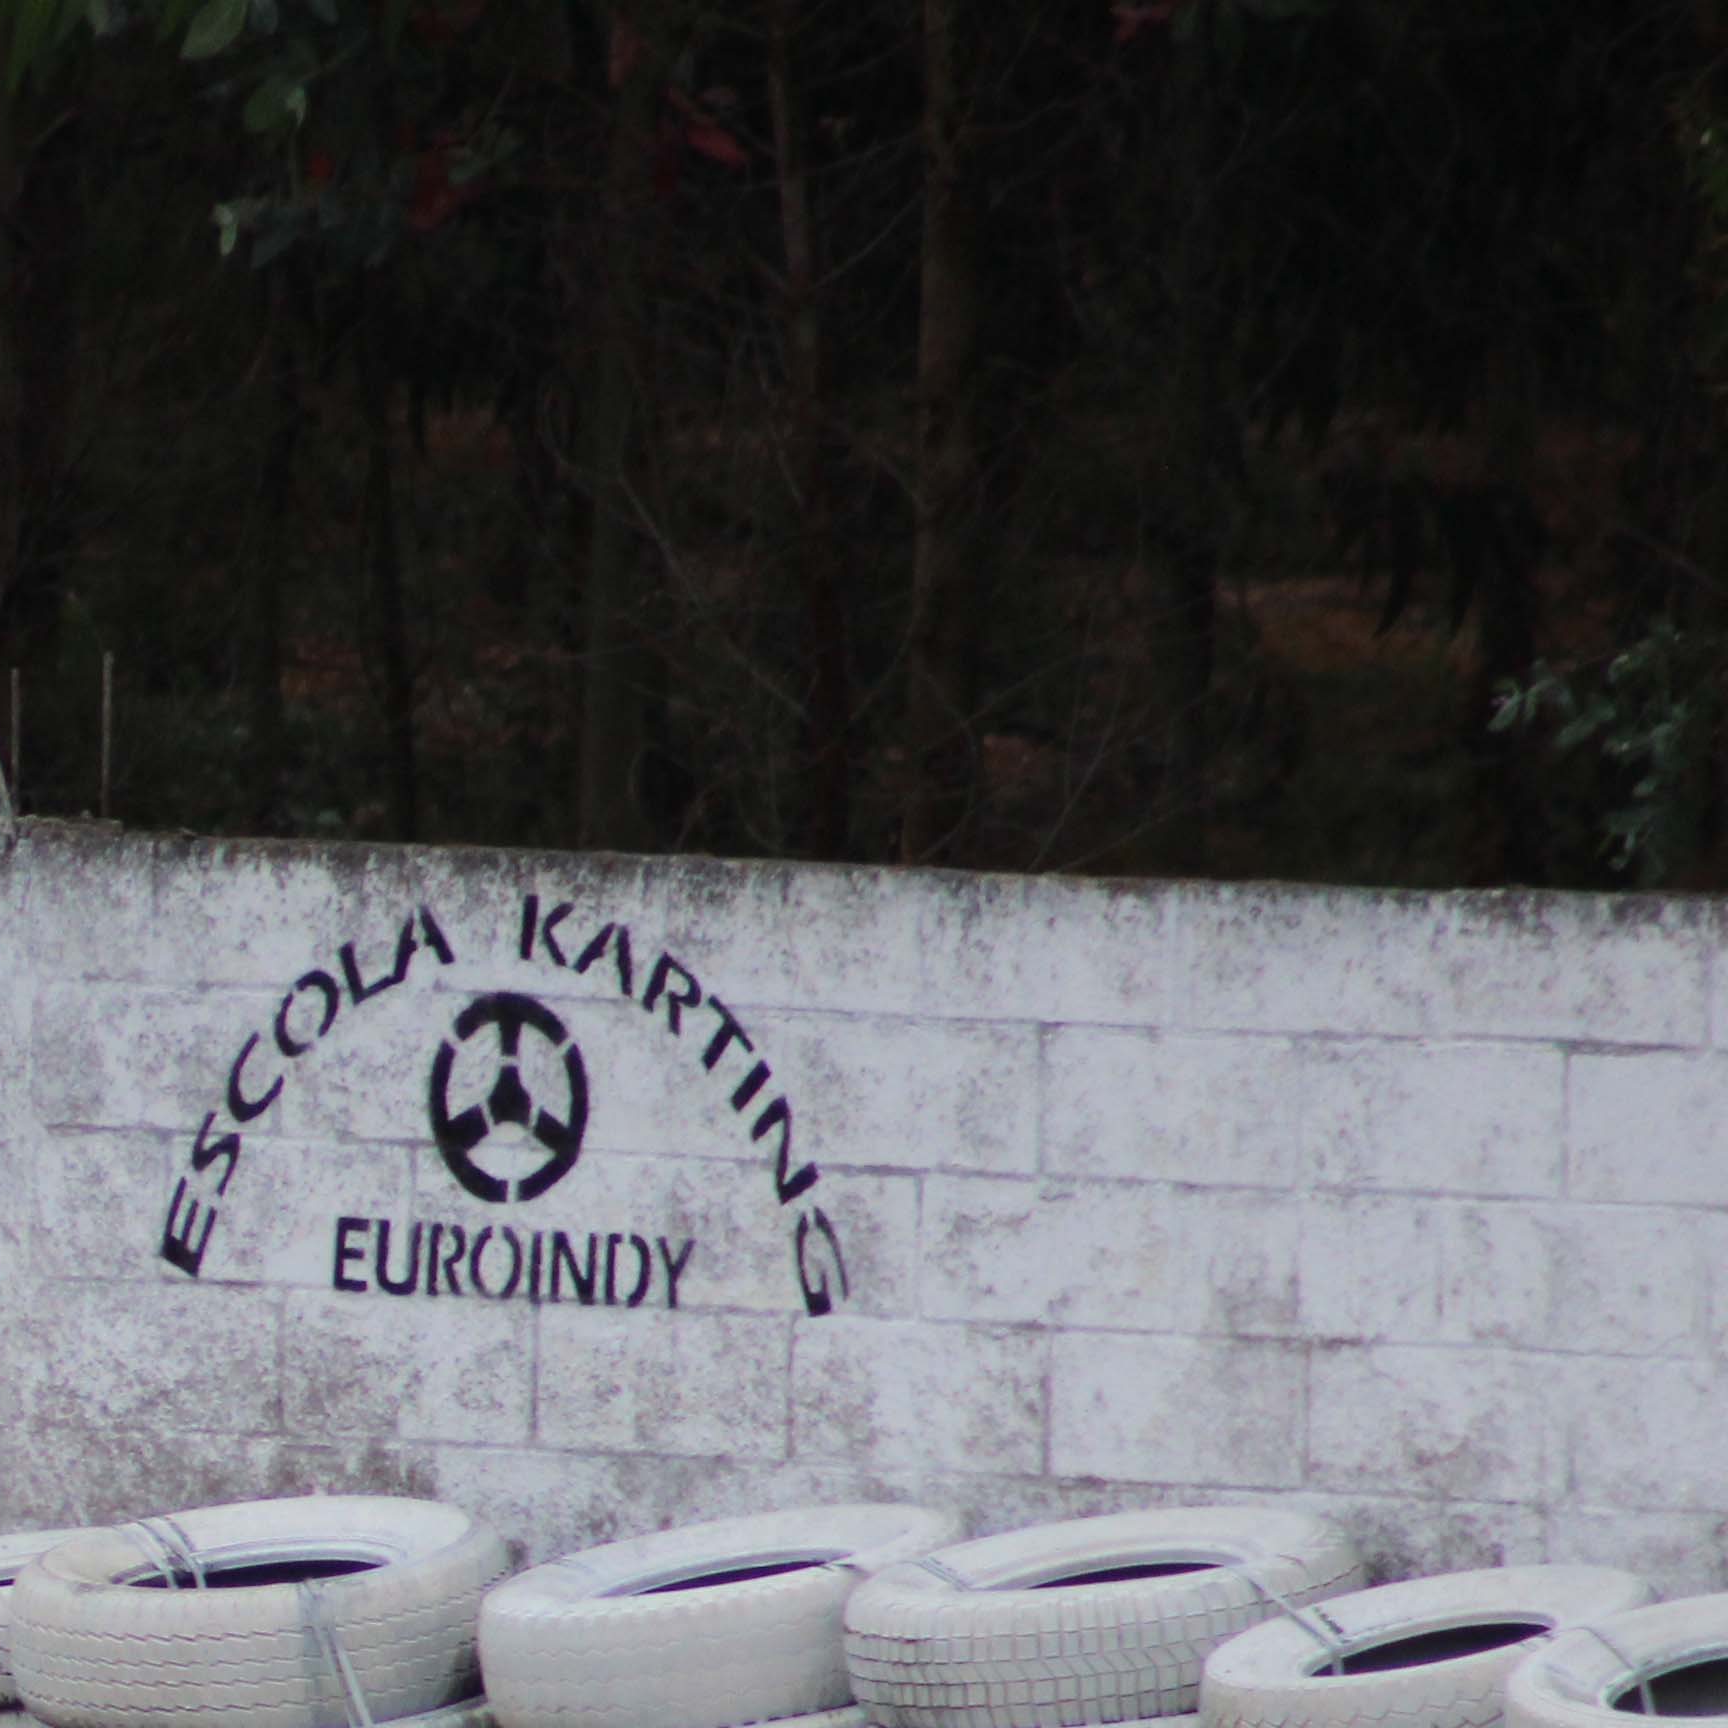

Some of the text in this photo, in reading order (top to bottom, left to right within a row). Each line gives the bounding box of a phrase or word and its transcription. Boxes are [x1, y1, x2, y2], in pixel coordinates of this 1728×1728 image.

[161, 894, 848, 1317] ESCOLA KARTING
[332, 1216, 696, 1308] EUROINDY
